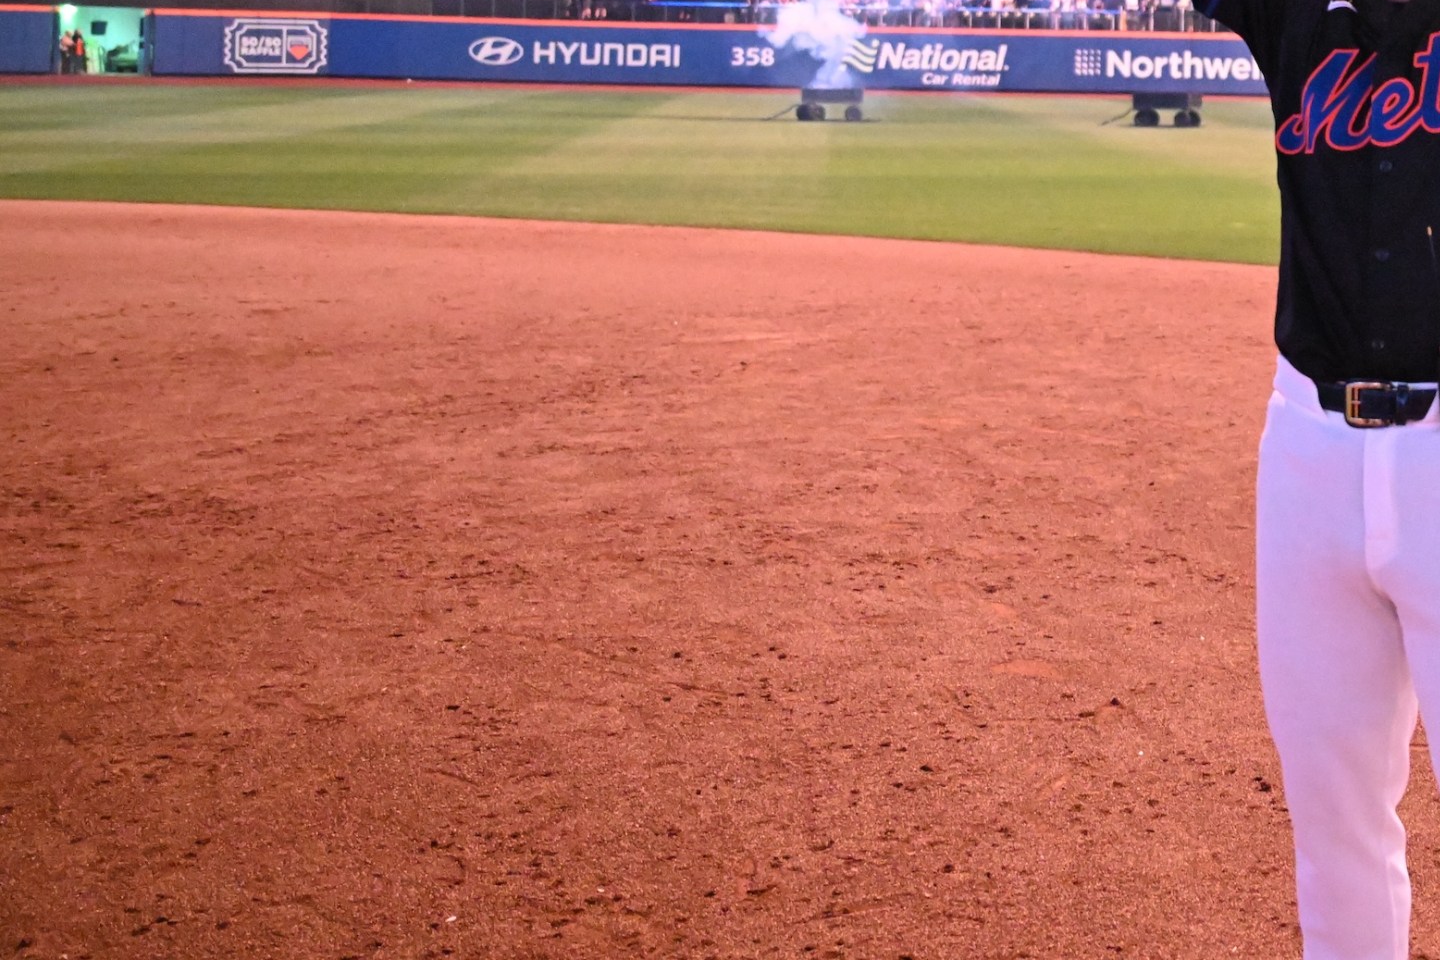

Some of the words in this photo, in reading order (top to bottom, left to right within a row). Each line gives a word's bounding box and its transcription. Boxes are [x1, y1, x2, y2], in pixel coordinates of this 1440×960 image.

[241, 36, 281, 47] 50/50
[533, 41, 681, 67] HYUNDAI
[731, 47, 775, 66] 358
[1106, 50, 1265, 80] Northwel
[922, 72, 947, 85] Car
[952, 73, 1000, 86] Rental
